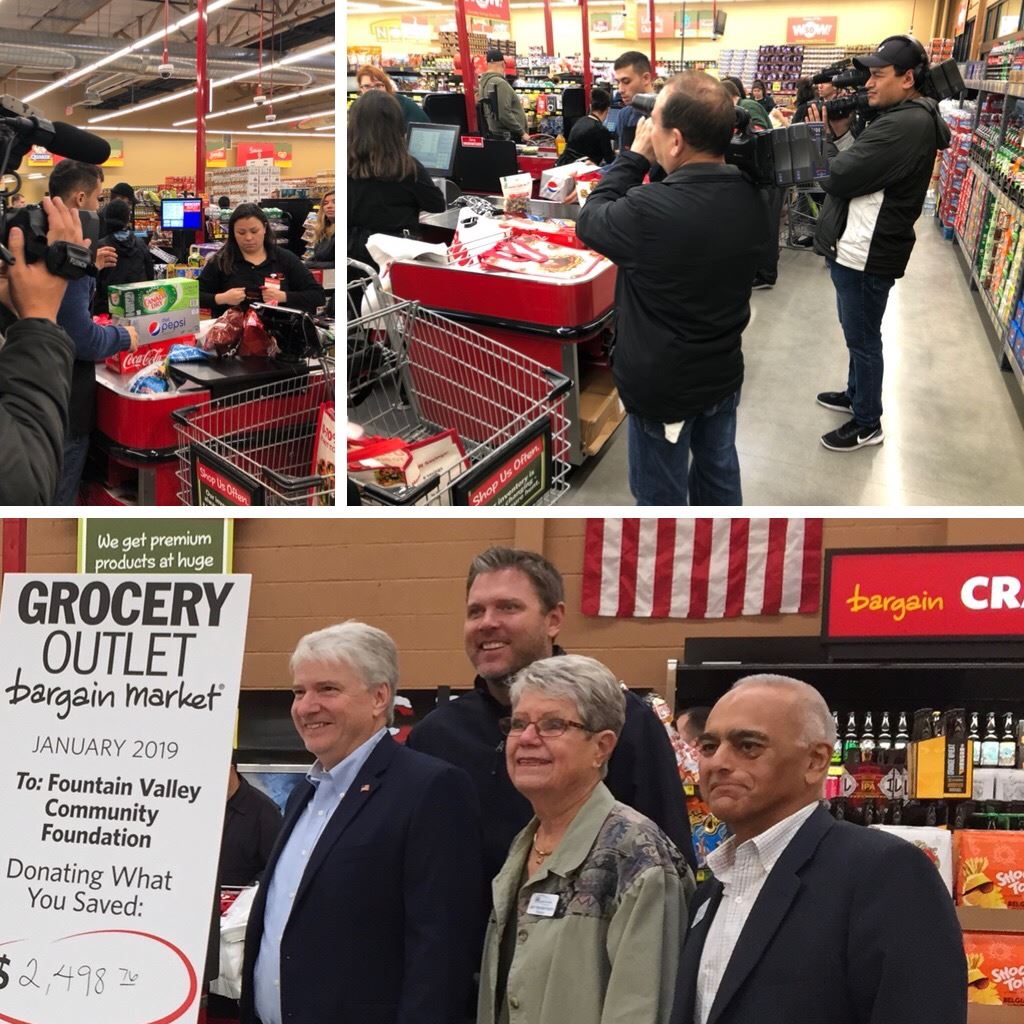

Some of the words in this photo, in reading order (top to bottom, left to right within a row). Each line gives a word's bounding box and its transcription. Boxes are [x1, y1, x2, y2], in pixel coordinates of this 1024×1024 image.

[160, 318, 186, 333] pepsi
[199, 466, 216, 485] Shop
[216, 474, 226, 491] Us
[472, 483, 499, 506] Shop
[499, 468, 513, 486] Us
[513, 446, 540, 470] Often.
[98, 533, 119, 549] We
[122, 532, 147, 551] get
[150, 531, 212, 551] premium
[95, 554, 156, 573] products
[159, 552, 175, 568] at
[178, 551, 214, 571] huge
[18, 580, 235, 627] GROCERY
[846, 583, 944, 621] bargain
[960, 575, 1024, 610] CR
[42, 629, 197, 677] OUTLET
[5, 667, 115, 720] bargain
[125, 680, 223, 712] market
[31, 735, 127, 758] JANUARY
[132, 740, 179, 760] 2019
[16, 771, 43, 791] To:
[48, 773, 133, 796] Fountain
[140, 778, 202, 804] Valley
[861, 780, 875, 791] IPA
[45, 798, 159, 827] Community
[41, 823, 152, 849] Foundation
[6, 857, 104, 890] Donating
[111, 865, 173, 891] What
[27, 886, 66, 911] You
[73, 891, 144, 917] Saved:
[18, 957, 107, 996] 2,498
